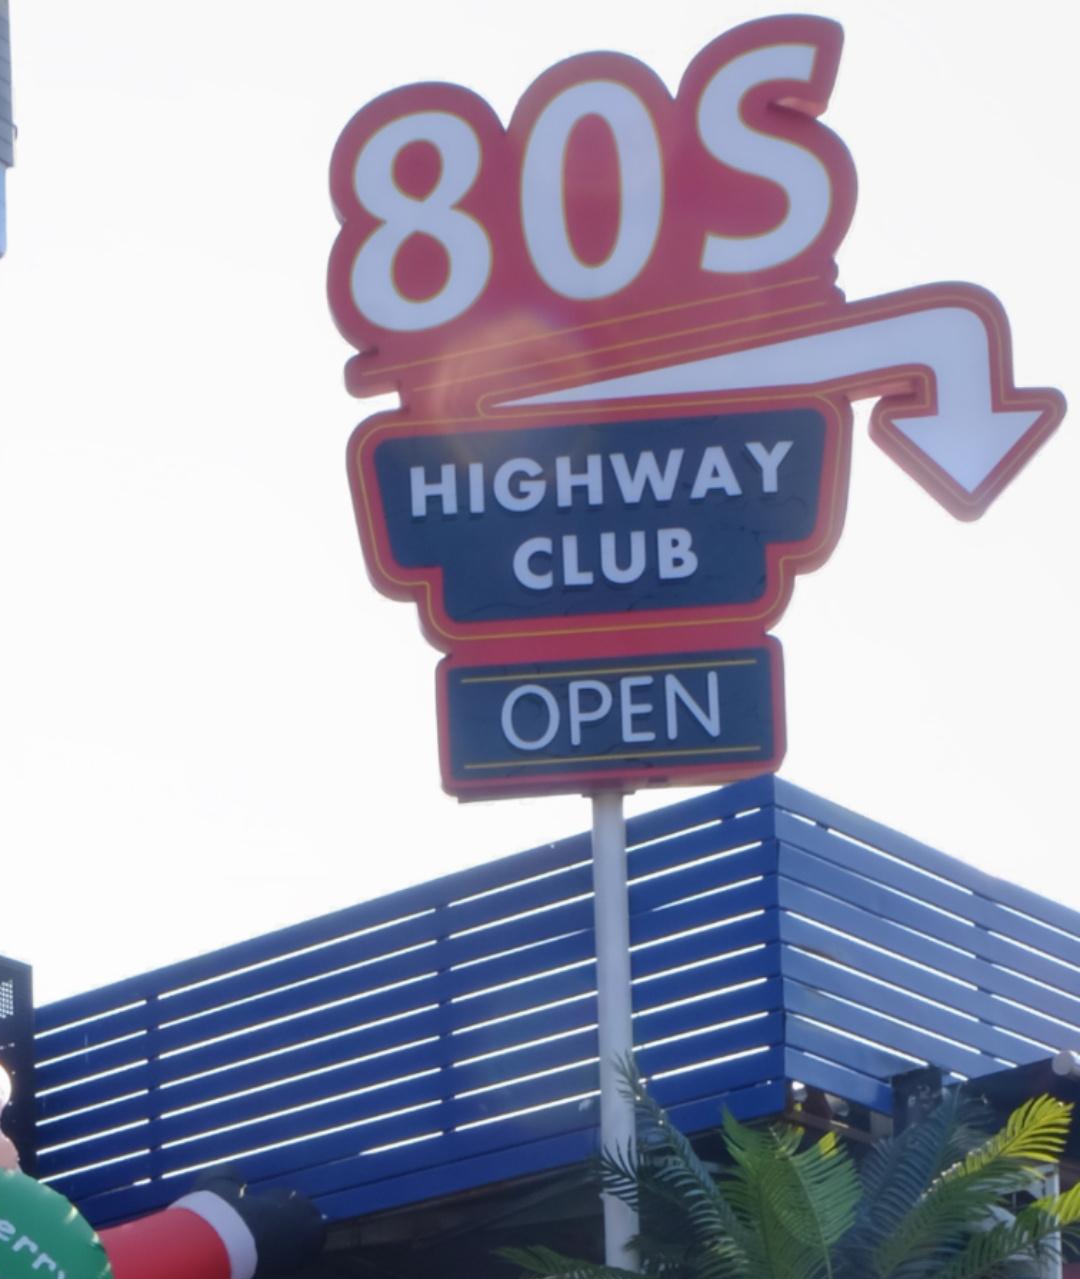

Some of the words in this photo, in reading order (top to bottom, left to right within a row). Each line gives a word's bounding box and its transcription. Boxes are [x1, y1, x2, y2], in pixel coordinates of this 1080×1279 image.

[350, 43, 833, 333] 80S
[408, 440, 795, 518] HIGHWAY
[512, 528, 699, 590] CLUB
[500, 670, 722, 751] OPEN
